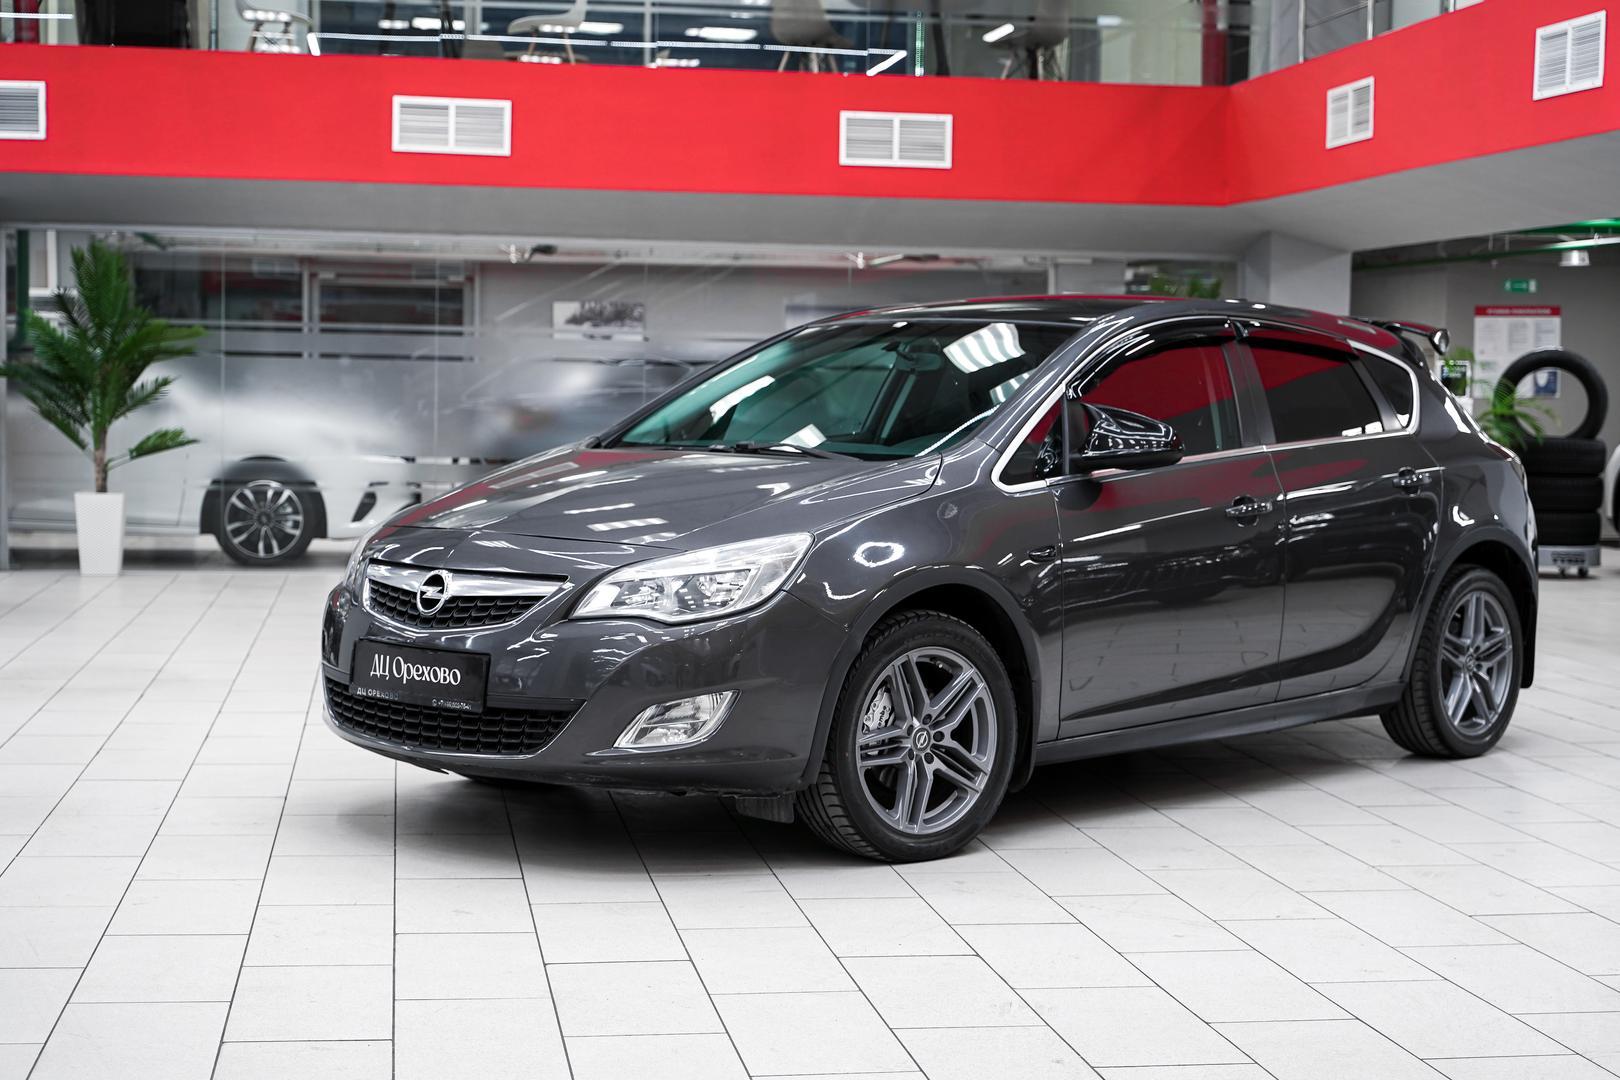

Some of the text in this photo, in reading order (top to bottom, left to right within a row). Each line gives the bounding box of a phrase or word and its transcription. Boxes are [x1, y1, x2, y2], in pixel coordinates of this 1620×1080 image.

[370, 653, 461, 686] ДЦ Орехово
[356, 687, 399, 701] ДЦ ОРЕХОВО
